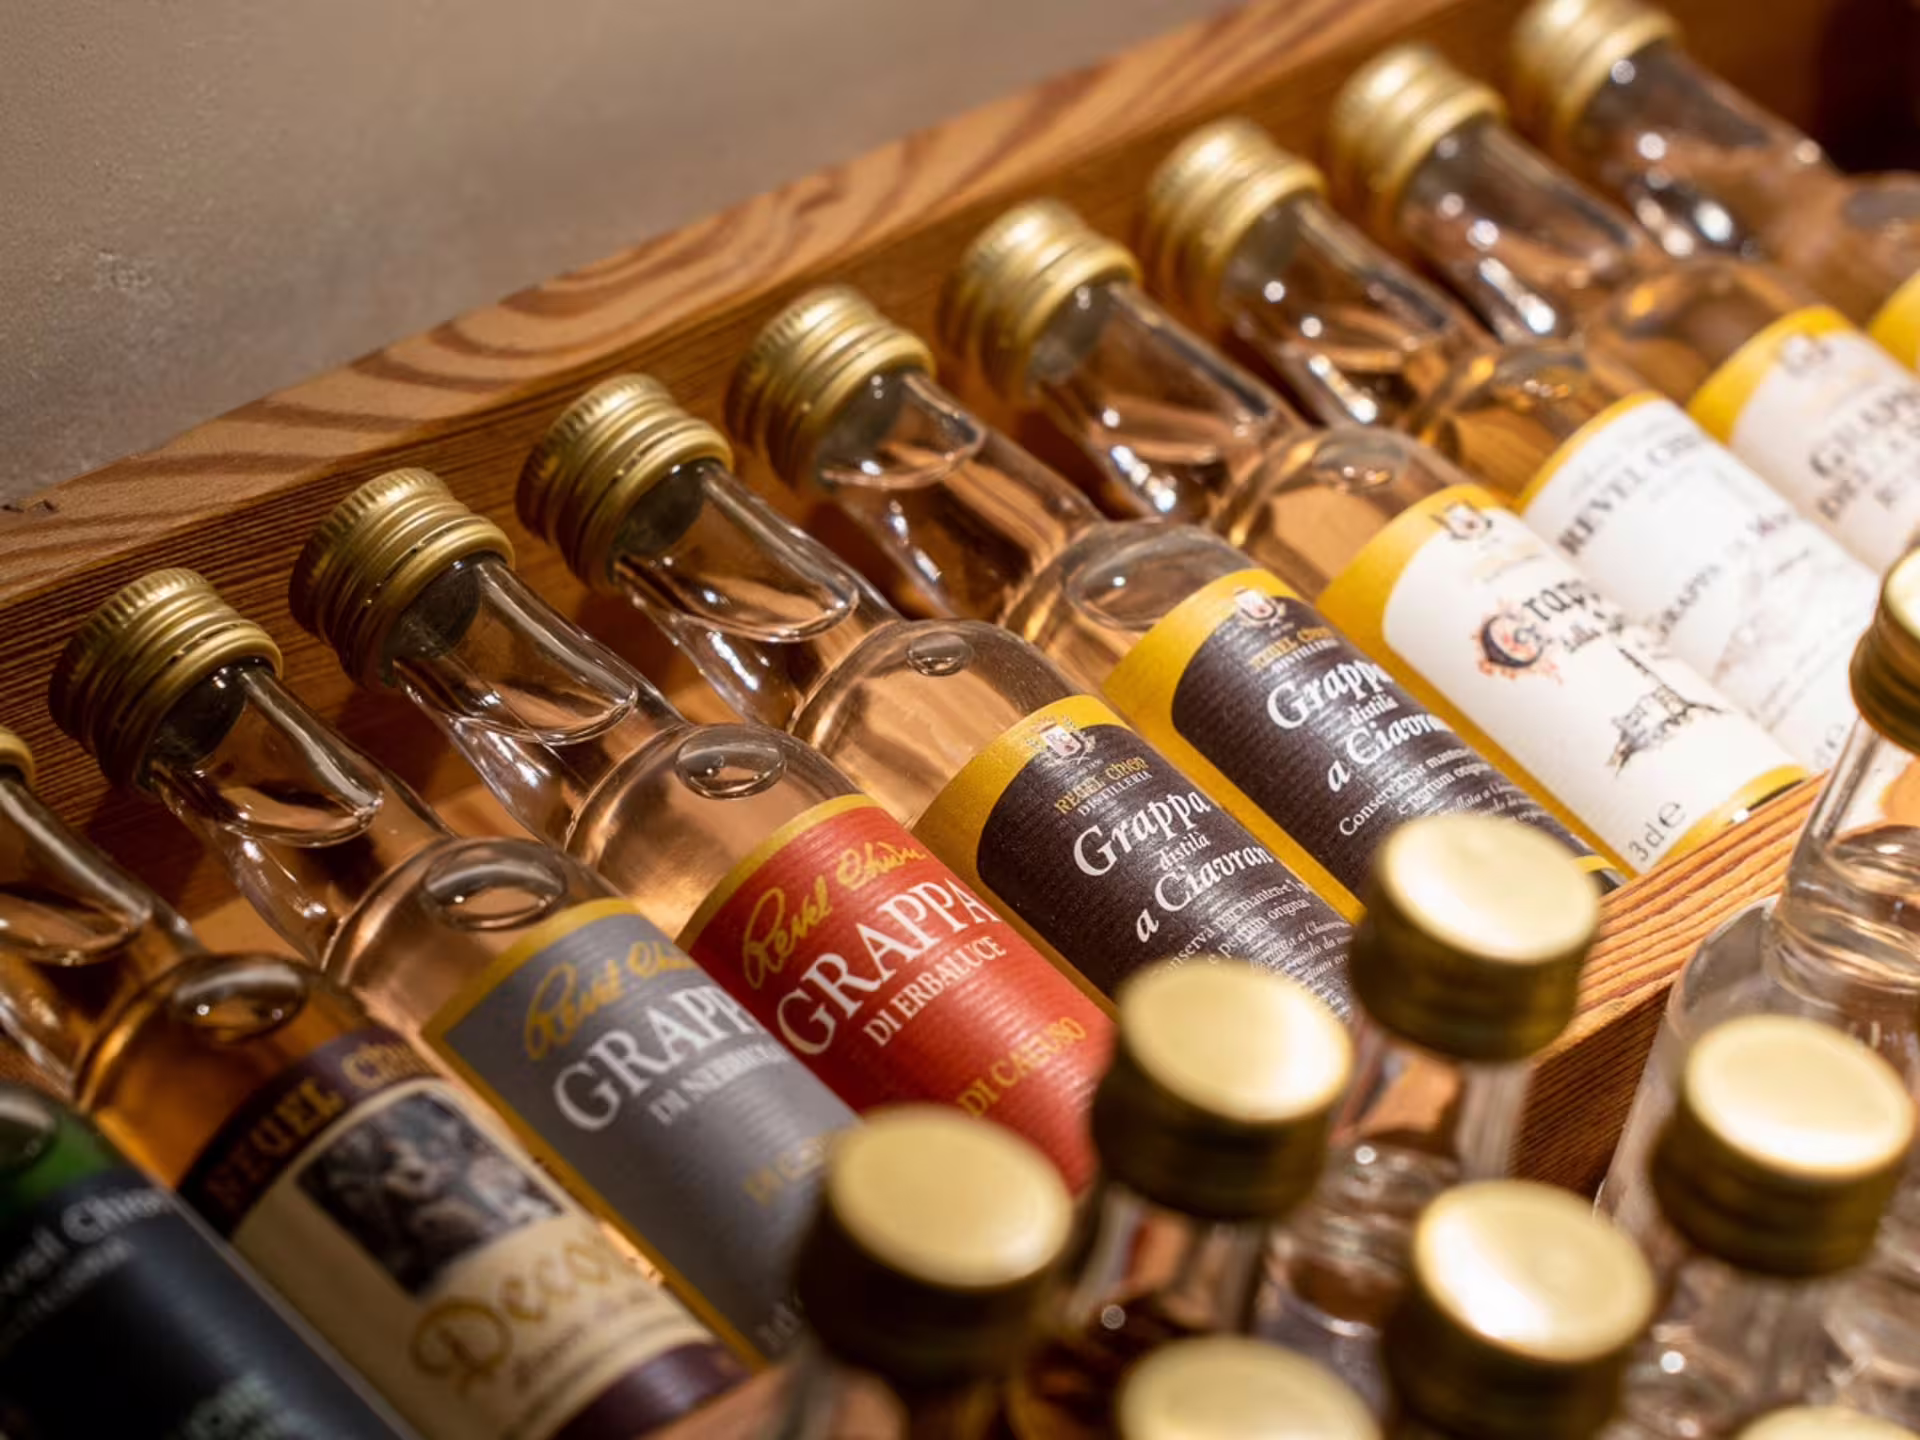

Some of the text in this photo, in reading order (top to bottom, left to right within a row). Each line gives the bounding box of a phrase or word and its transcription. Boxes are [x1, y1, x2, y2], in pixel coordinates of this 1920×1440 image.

[1077, 770, 1153, 817] DISTILLERIA
[1328, 760, 1351, 792] a
[1073, 791, 1212, 877] Grappa
[1157, 831, 1212, 872] distilà
[1136, 846, 1275, 943] a Ciavran
[776, 877, 1003, 1055] GRAPPA
[862, 934, 1007, 1047] DI ERBALUCE
[552, 984, 768, 1132] GRAPP
[957, 1077, 998, 1119] DI
